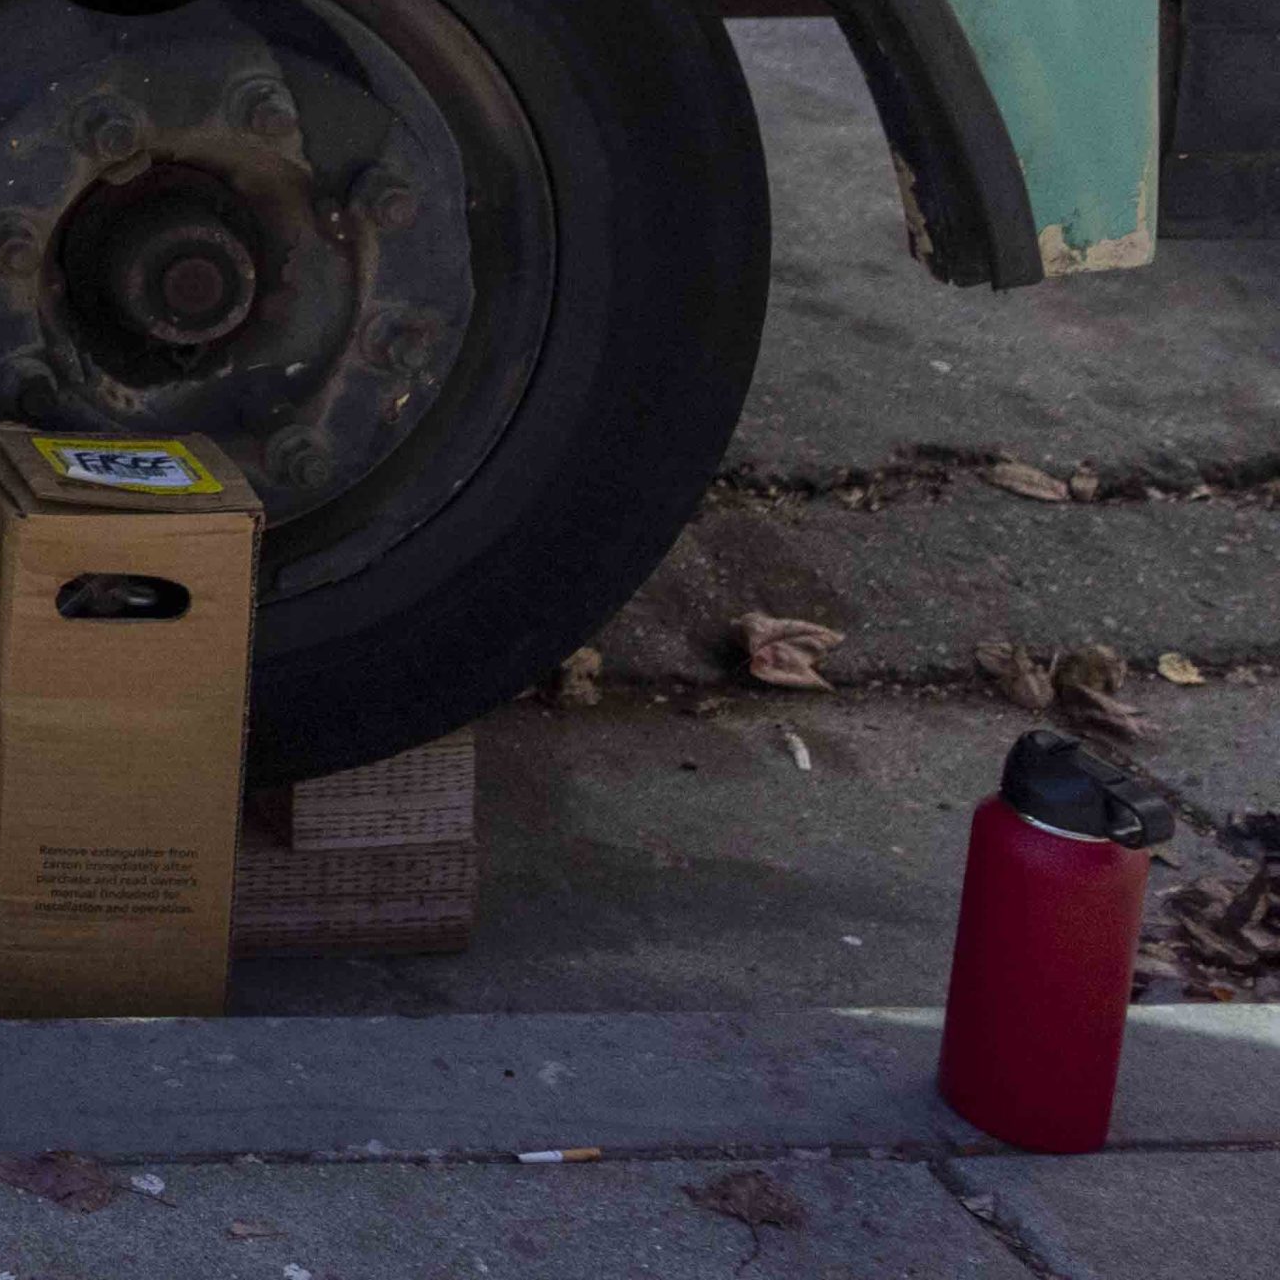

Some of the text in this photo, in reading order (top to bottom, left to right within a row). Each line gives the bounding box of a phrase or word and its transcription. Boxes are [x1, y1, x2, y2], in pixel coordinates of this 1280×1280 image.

[39, 845, 199, 859] Remove extinguisher from
[43, 860, 193, 873] carton immediately after
[36, 874, 198, 887] purchase and read owner's
[50, 888, 181, 901] manual (included) for
[34, 901, 102, 913] installation
[105, 903, 129, 913] and
